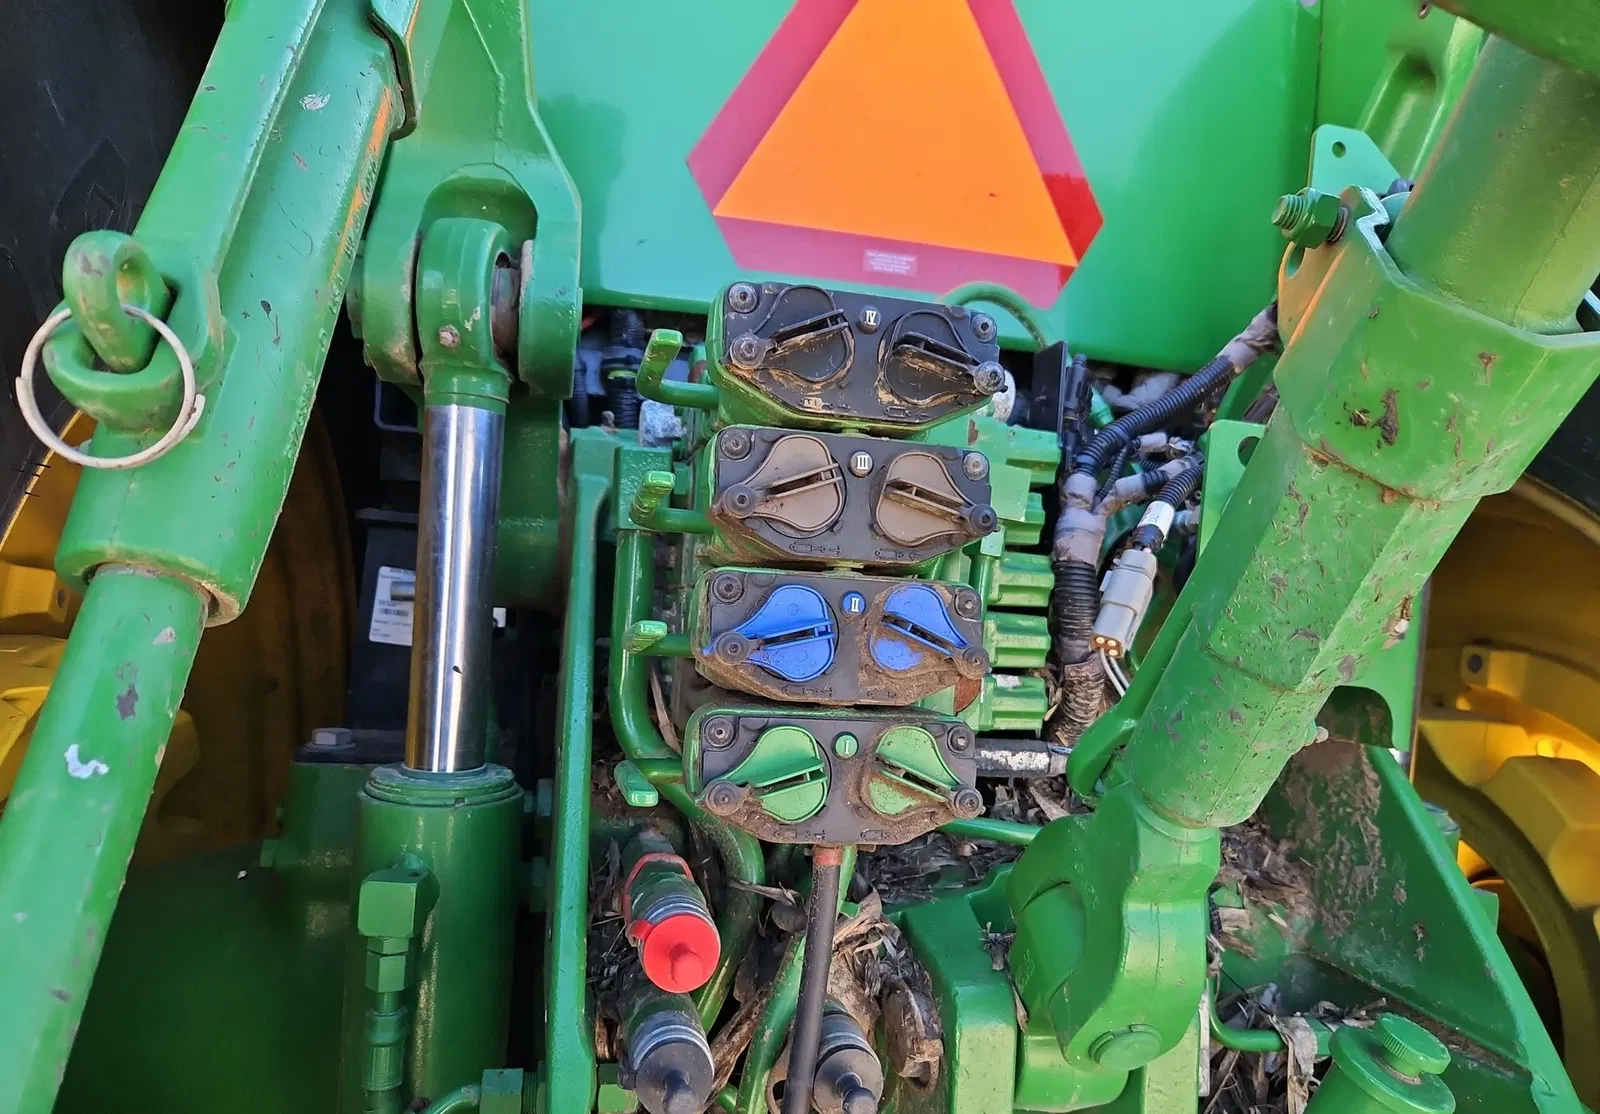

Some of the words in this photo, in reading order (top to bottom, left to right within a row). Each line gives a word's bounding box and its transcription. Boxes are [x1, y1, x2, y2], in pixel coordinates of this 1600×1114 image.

[864, 310, 877, 325] IV
[856, 455, 868, 470] III
[851, 597, 860, 612] II
[845, 740, 850, 754] I
